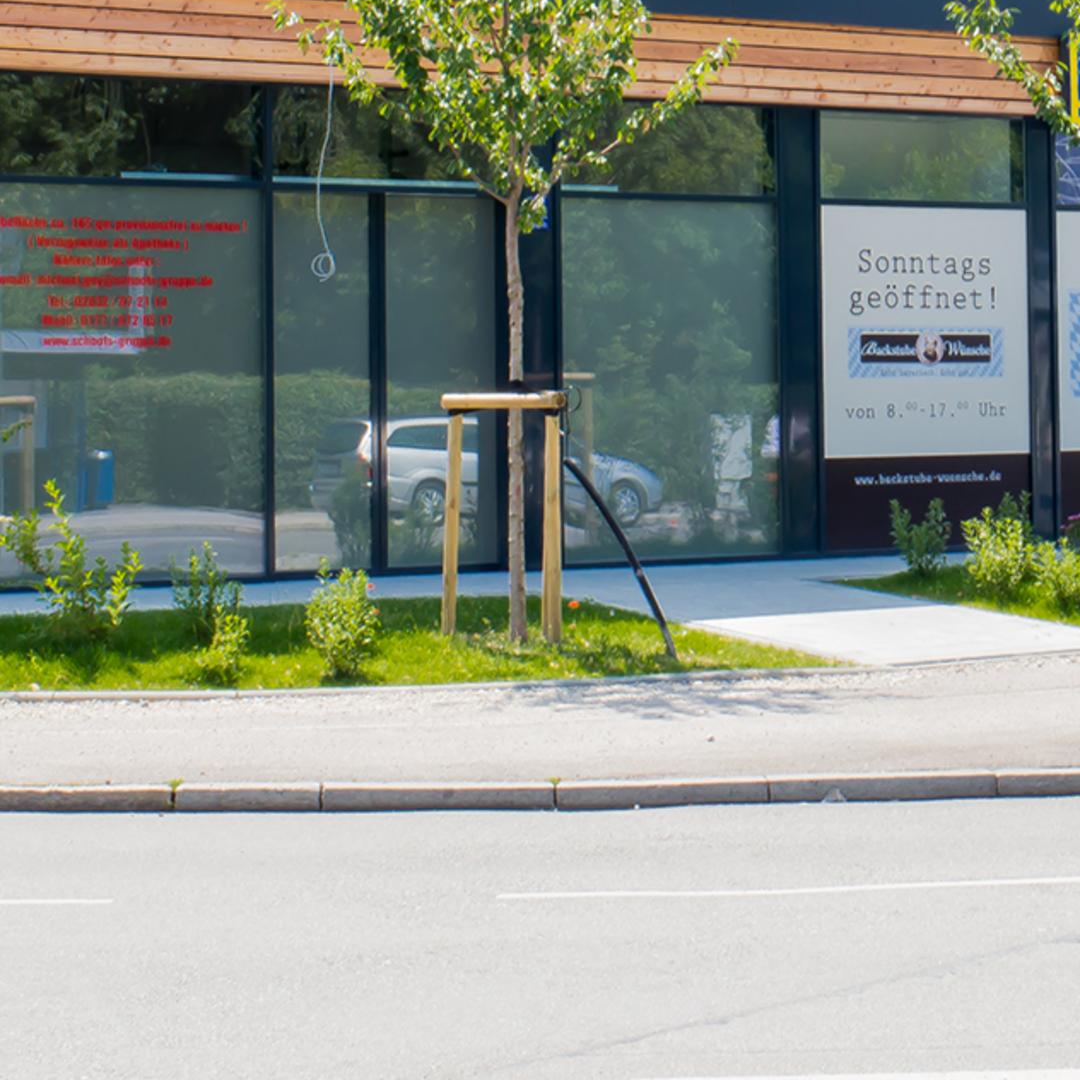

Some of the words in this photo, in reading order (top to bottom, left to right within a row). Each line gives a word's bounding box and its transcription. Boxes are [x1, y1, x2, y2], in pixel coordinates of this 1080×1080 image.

[858, 248, 992, 282] Sonntags
[850, 284, 996, 316] geöffnet!
[845, 407, 876, 419] von
[979, 401, 1007, 418] Uhr
